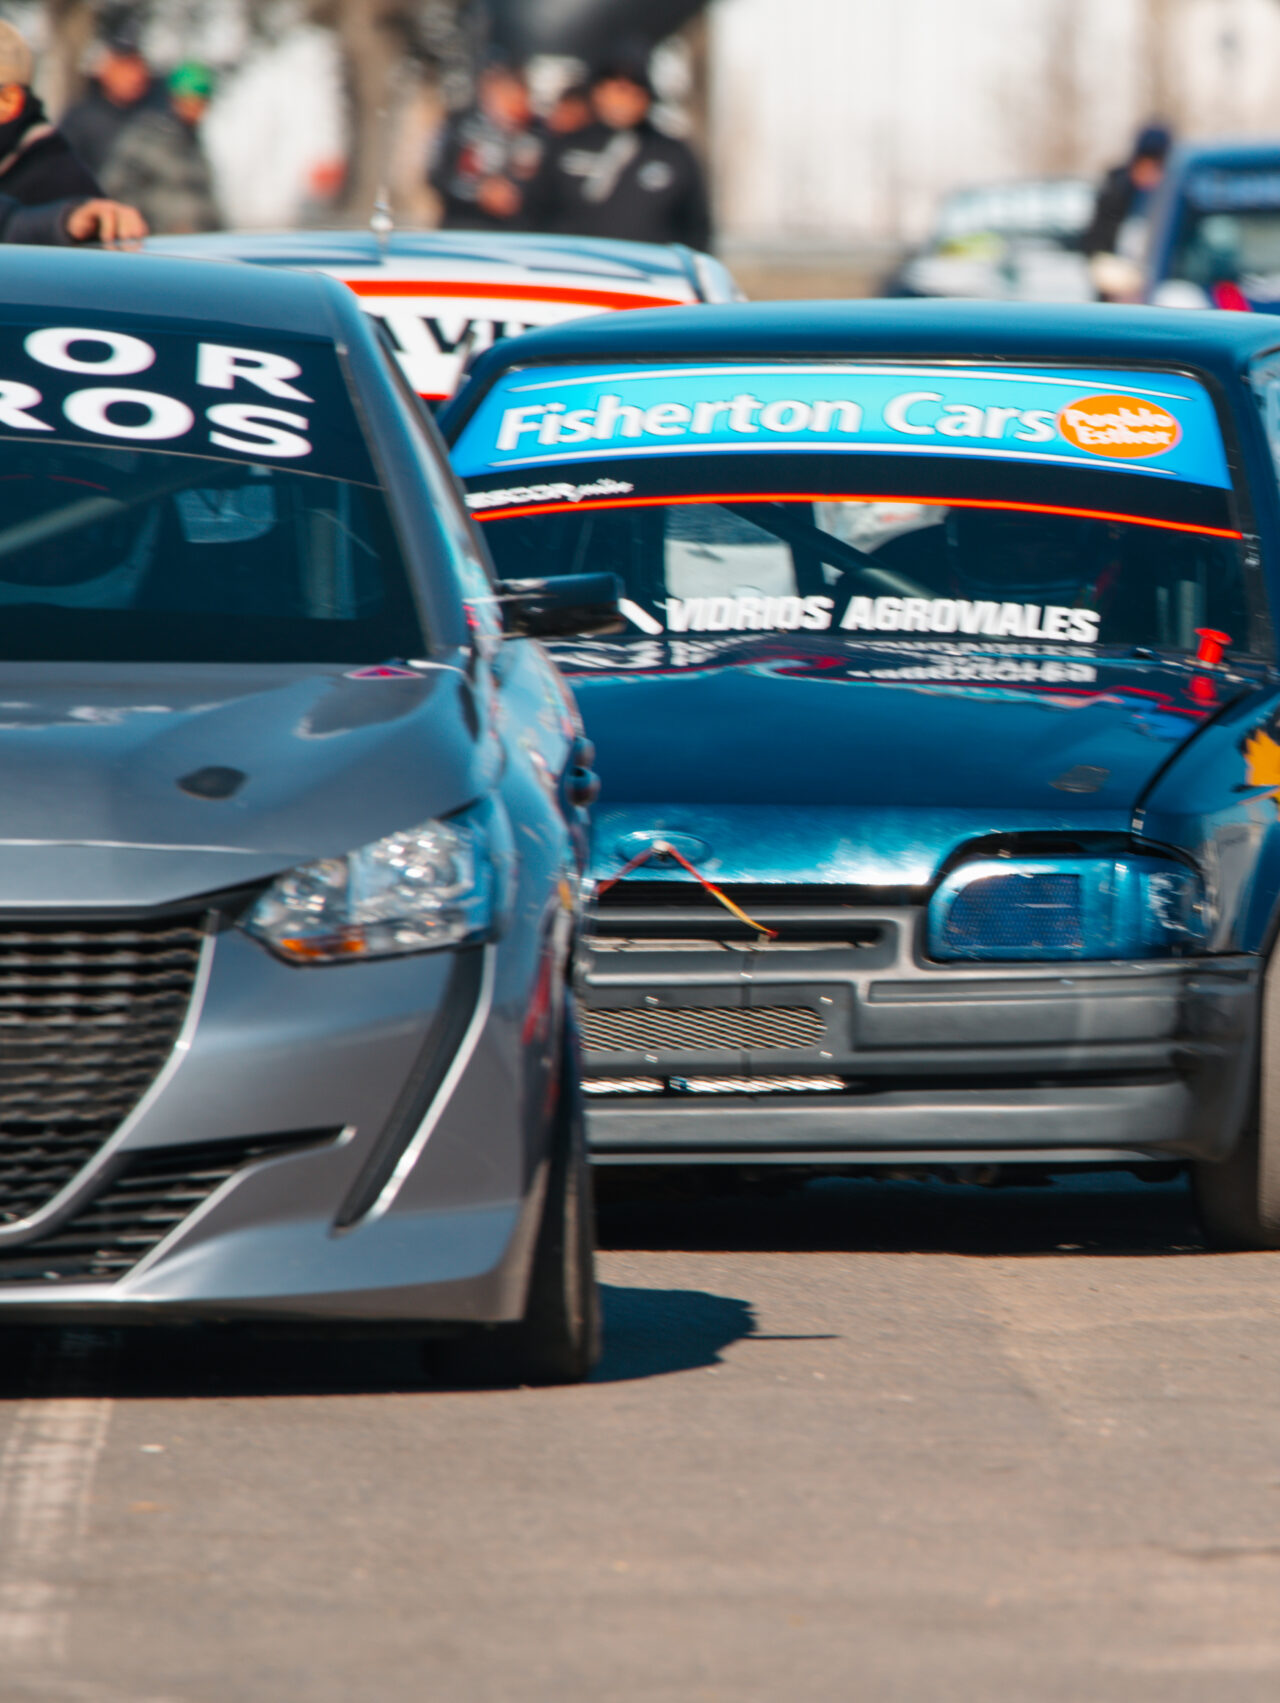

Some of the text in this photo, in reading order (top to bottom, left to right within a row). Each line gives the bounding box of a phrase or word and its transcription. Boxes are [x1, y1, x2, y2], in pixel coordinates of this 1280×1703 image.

[495, 391, 1057, 451] Fisherton Cars
[664, 595, 1101, 644] VIDRIOS AGROVIALES
